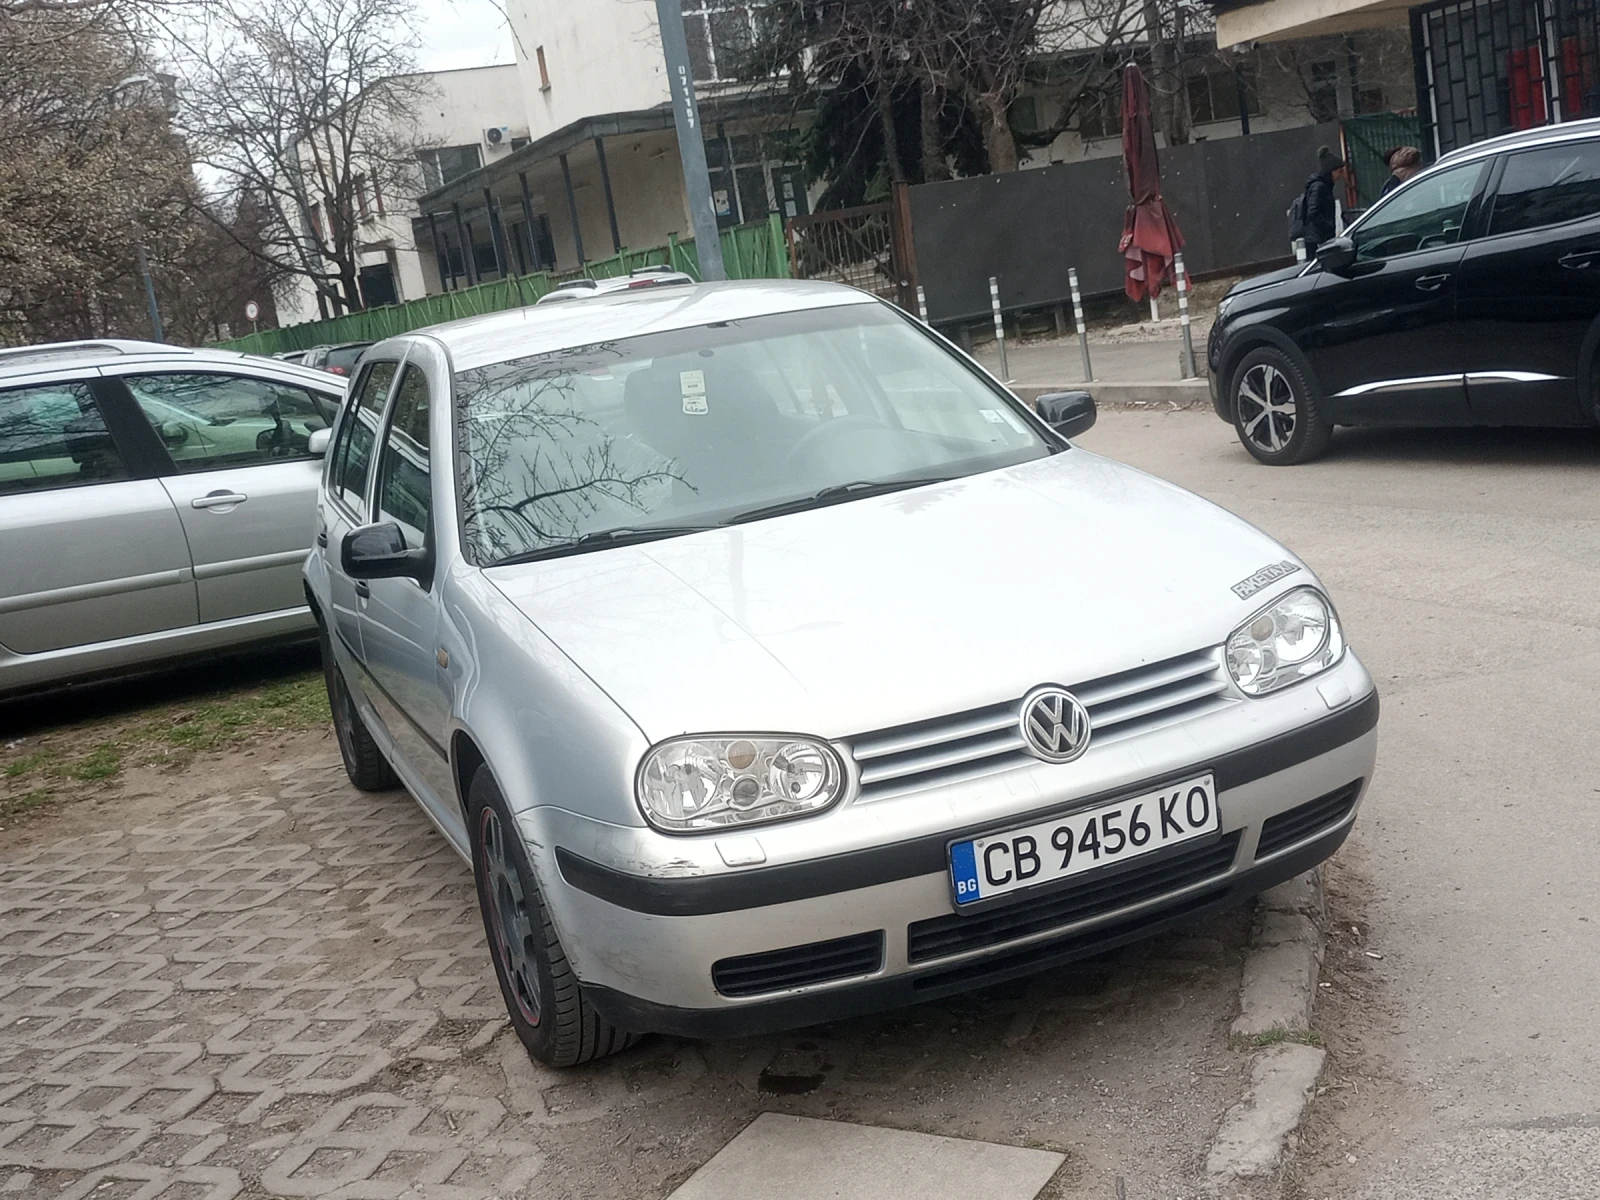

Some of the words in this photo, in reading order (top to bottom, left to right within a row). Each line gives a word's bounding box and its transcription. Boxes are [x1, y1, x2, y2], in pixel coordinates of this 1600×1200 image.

[1025, 692, 1086, 758] VW
[983, 835, 1041, 887] CB
[1051, 803, 1151, 870] 9456
[1158, 785, 1210, 839] KO
[957, 878, 977, 895] BG
